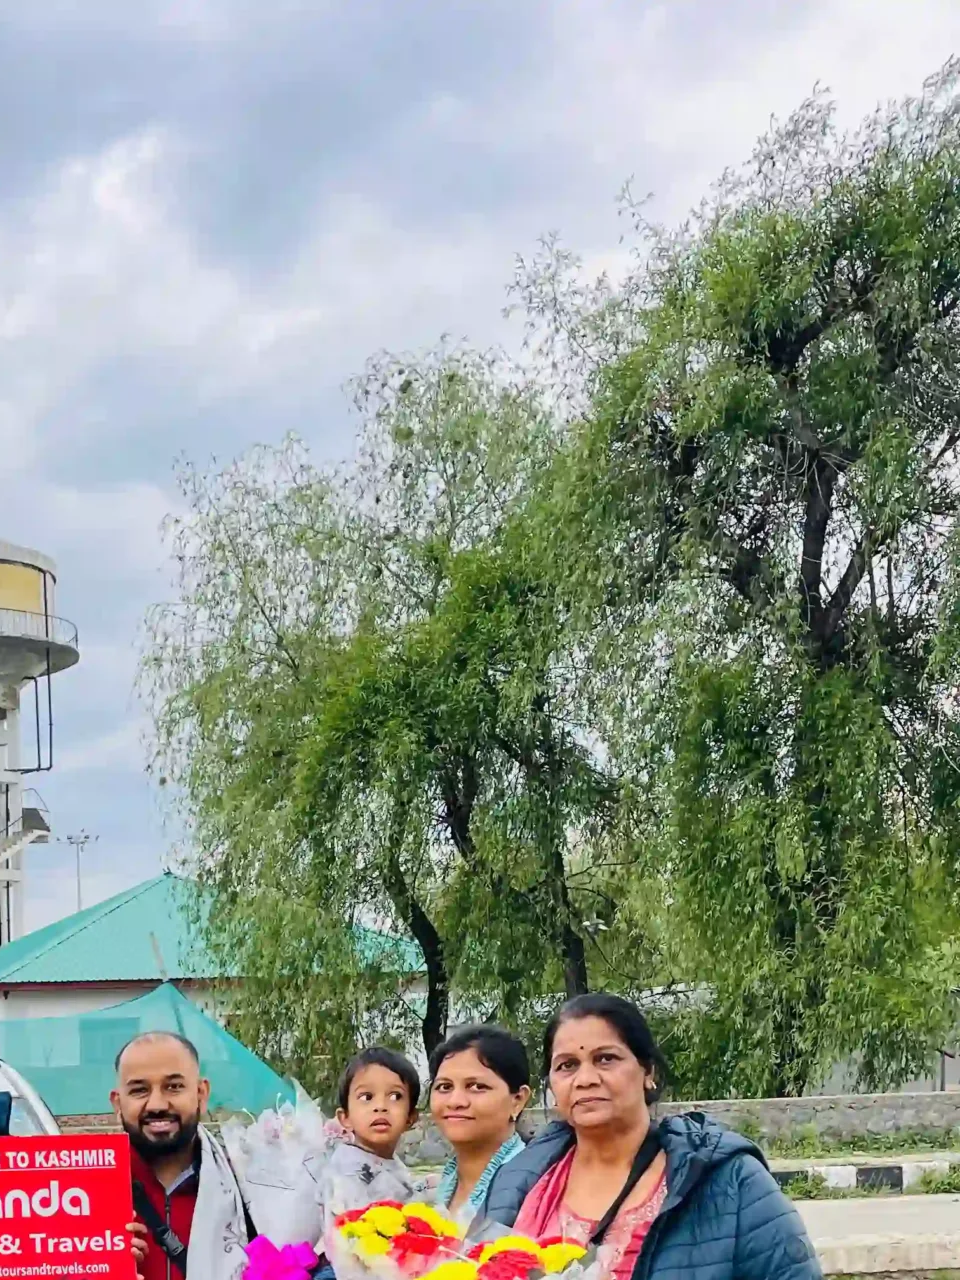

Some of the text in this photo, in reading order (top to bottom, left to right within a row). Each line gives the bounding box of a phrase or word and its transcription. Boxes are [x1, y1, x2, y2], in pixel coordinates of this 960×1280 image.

[5, 1151, 29, 1169] TO
[35, 1148, 116, 1168] KASHMIR
[29, 1230, 125, 1254] Travels
